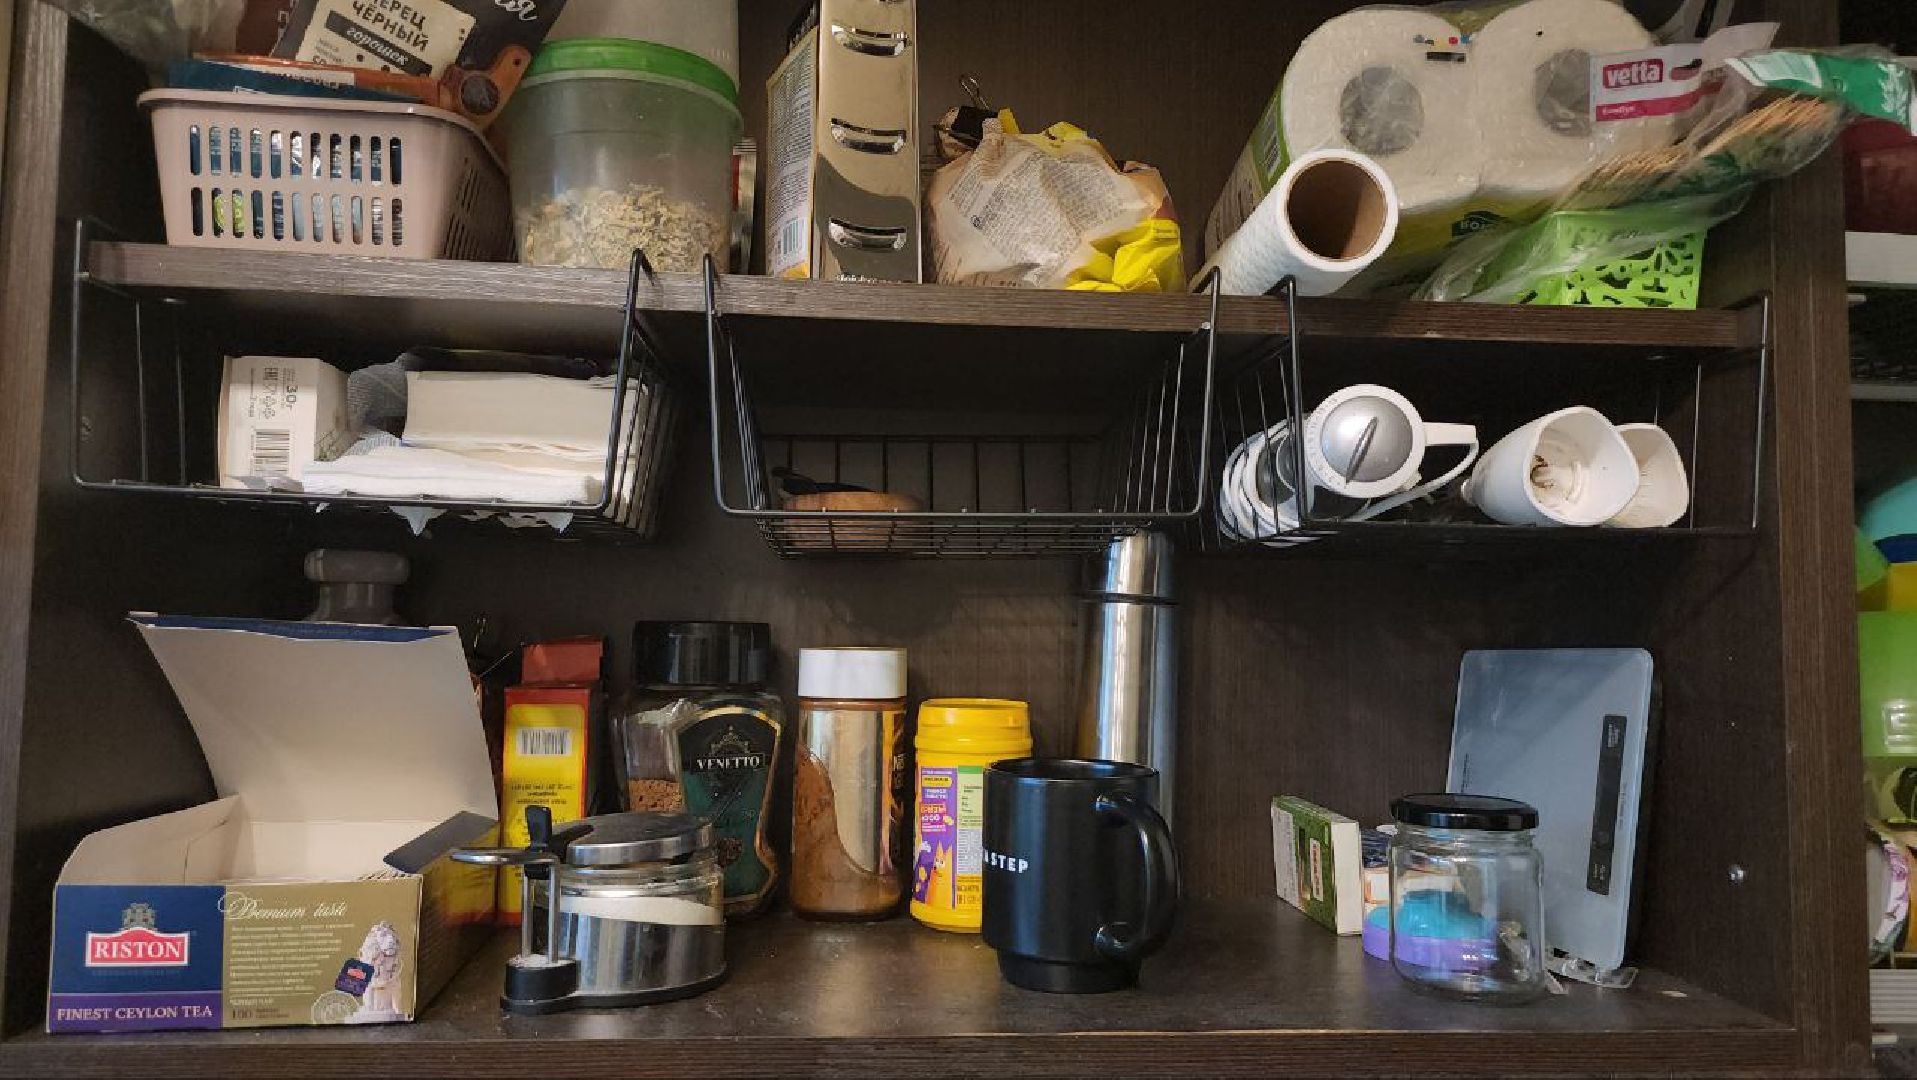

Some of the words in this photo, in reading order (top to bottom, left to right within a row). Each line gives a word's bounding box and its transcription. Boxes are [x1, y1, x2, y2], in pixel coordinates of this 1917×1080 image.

[352, 1, 429, 51] ЧЁРНЫЙ
[373, 0, 426, 31] ЕРЕЦ
[346, 27, 409, 66] горошек
[1607, 61, 1661, 86] vetta
[697, 755, 760, 770] VENETTO
[217, 891, 307, 919] Premium
[94, 941, 182, 959] RISTON
[57, 1008, 112, 1021] FINEST
[115, 1005, 177, 1019] CEYLON
[182, 1005, 213, 1018] TEA
